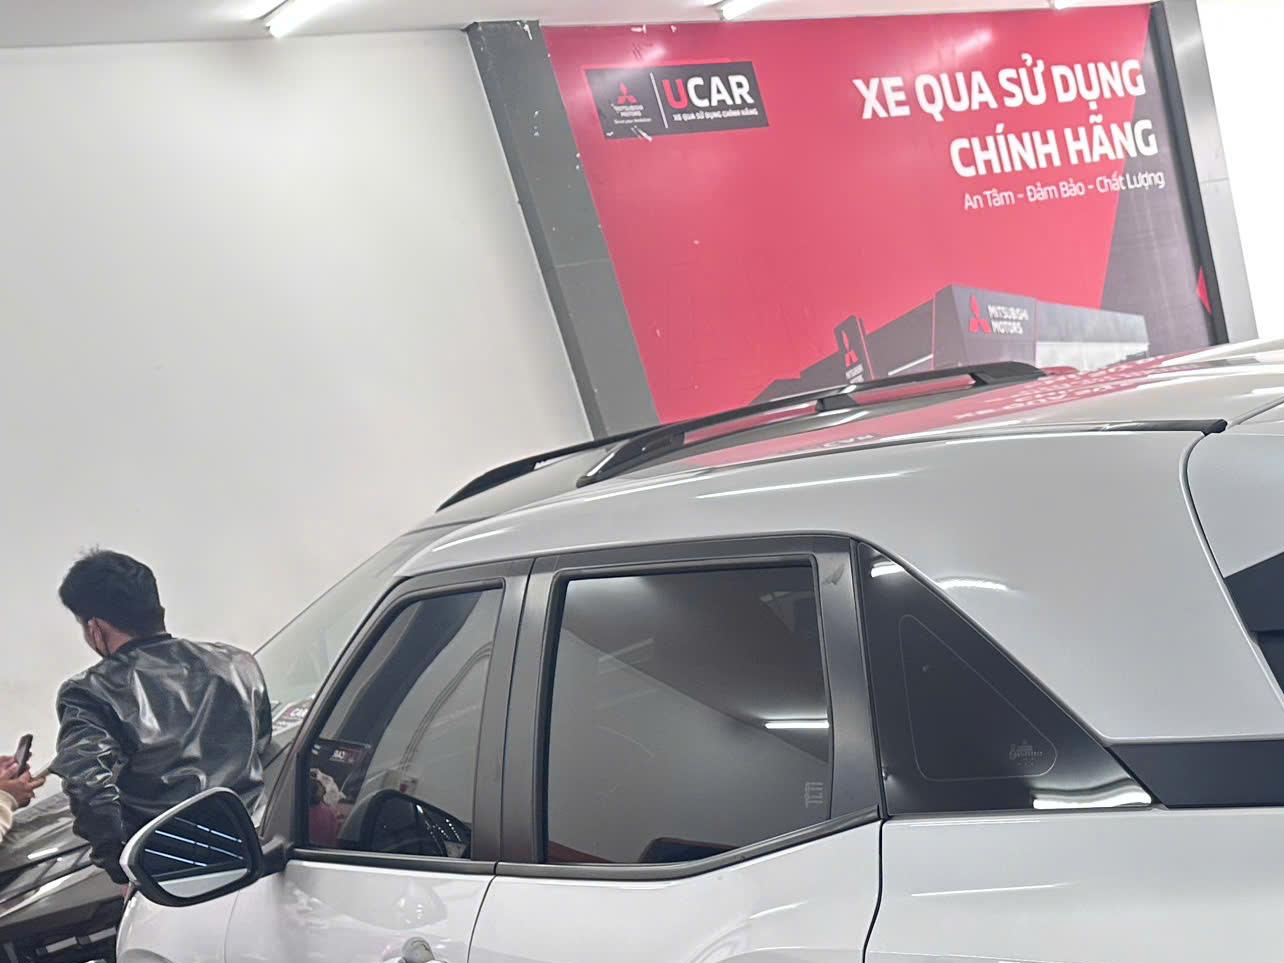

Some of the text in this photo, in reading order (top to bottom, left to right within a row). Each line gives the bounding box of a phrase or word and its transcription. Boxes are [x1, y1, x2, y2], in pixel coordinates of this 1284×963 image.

[662, 75, 755, 109] UCAR
[853, 53, 1146, 122] XE QUA SỬ DỤNG
[682, 112, 696, 121] QUA
[950, 114, 1158, 177] CHÍNH HÃNG
[964, 192, 983, 210] An
[983, 188, 1015, 207] Tâm
[1026, 182, 1058, 202] Đảm
[1059, 177, 1085, 198] Bảo
[1096, 171, 1125, 193] Chất
[1127, 171, 1166, 191] Lượng
